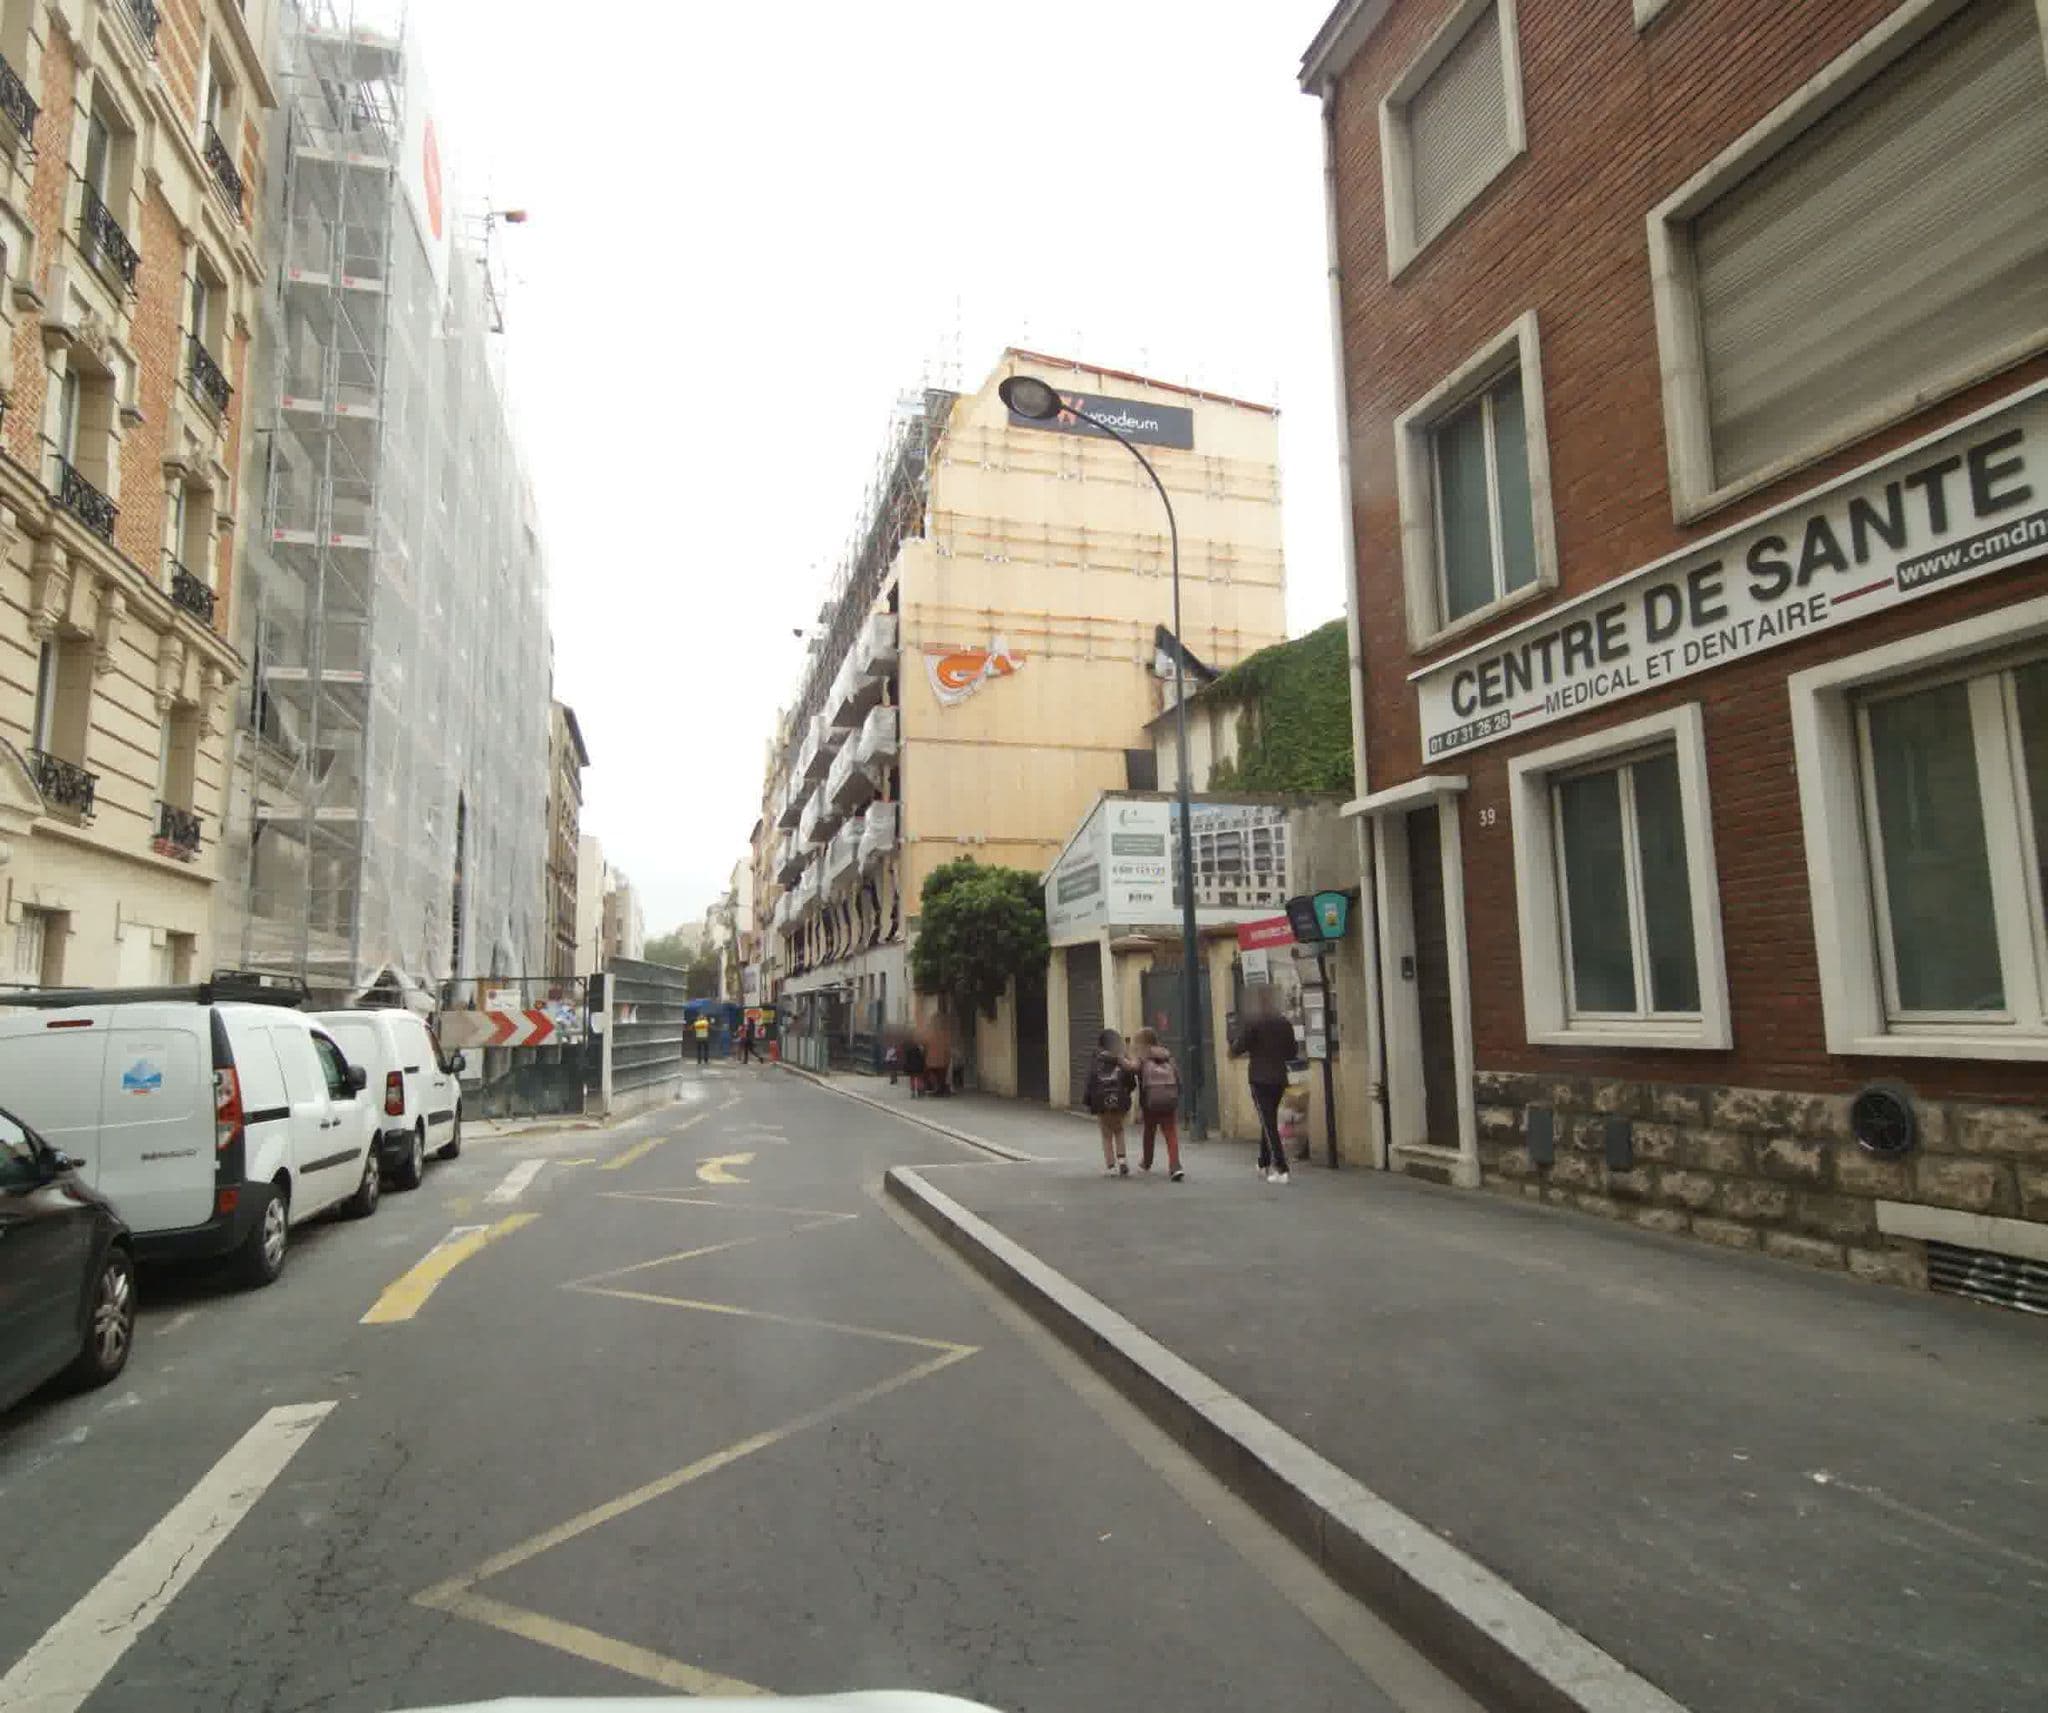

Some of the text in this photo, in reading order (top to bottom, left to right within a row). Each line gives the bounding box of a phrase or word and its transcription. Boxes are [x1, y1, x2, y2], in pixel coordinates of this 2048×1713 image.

[1452, 428, 2032, 717] CENTRE DE SANTE
[1901, 518, 2048, 583] www.cmdn
[1545, 594, 1830, 715] MEDICAL ET DENTAIRE
[1430, 736, 1443, 753] 01
